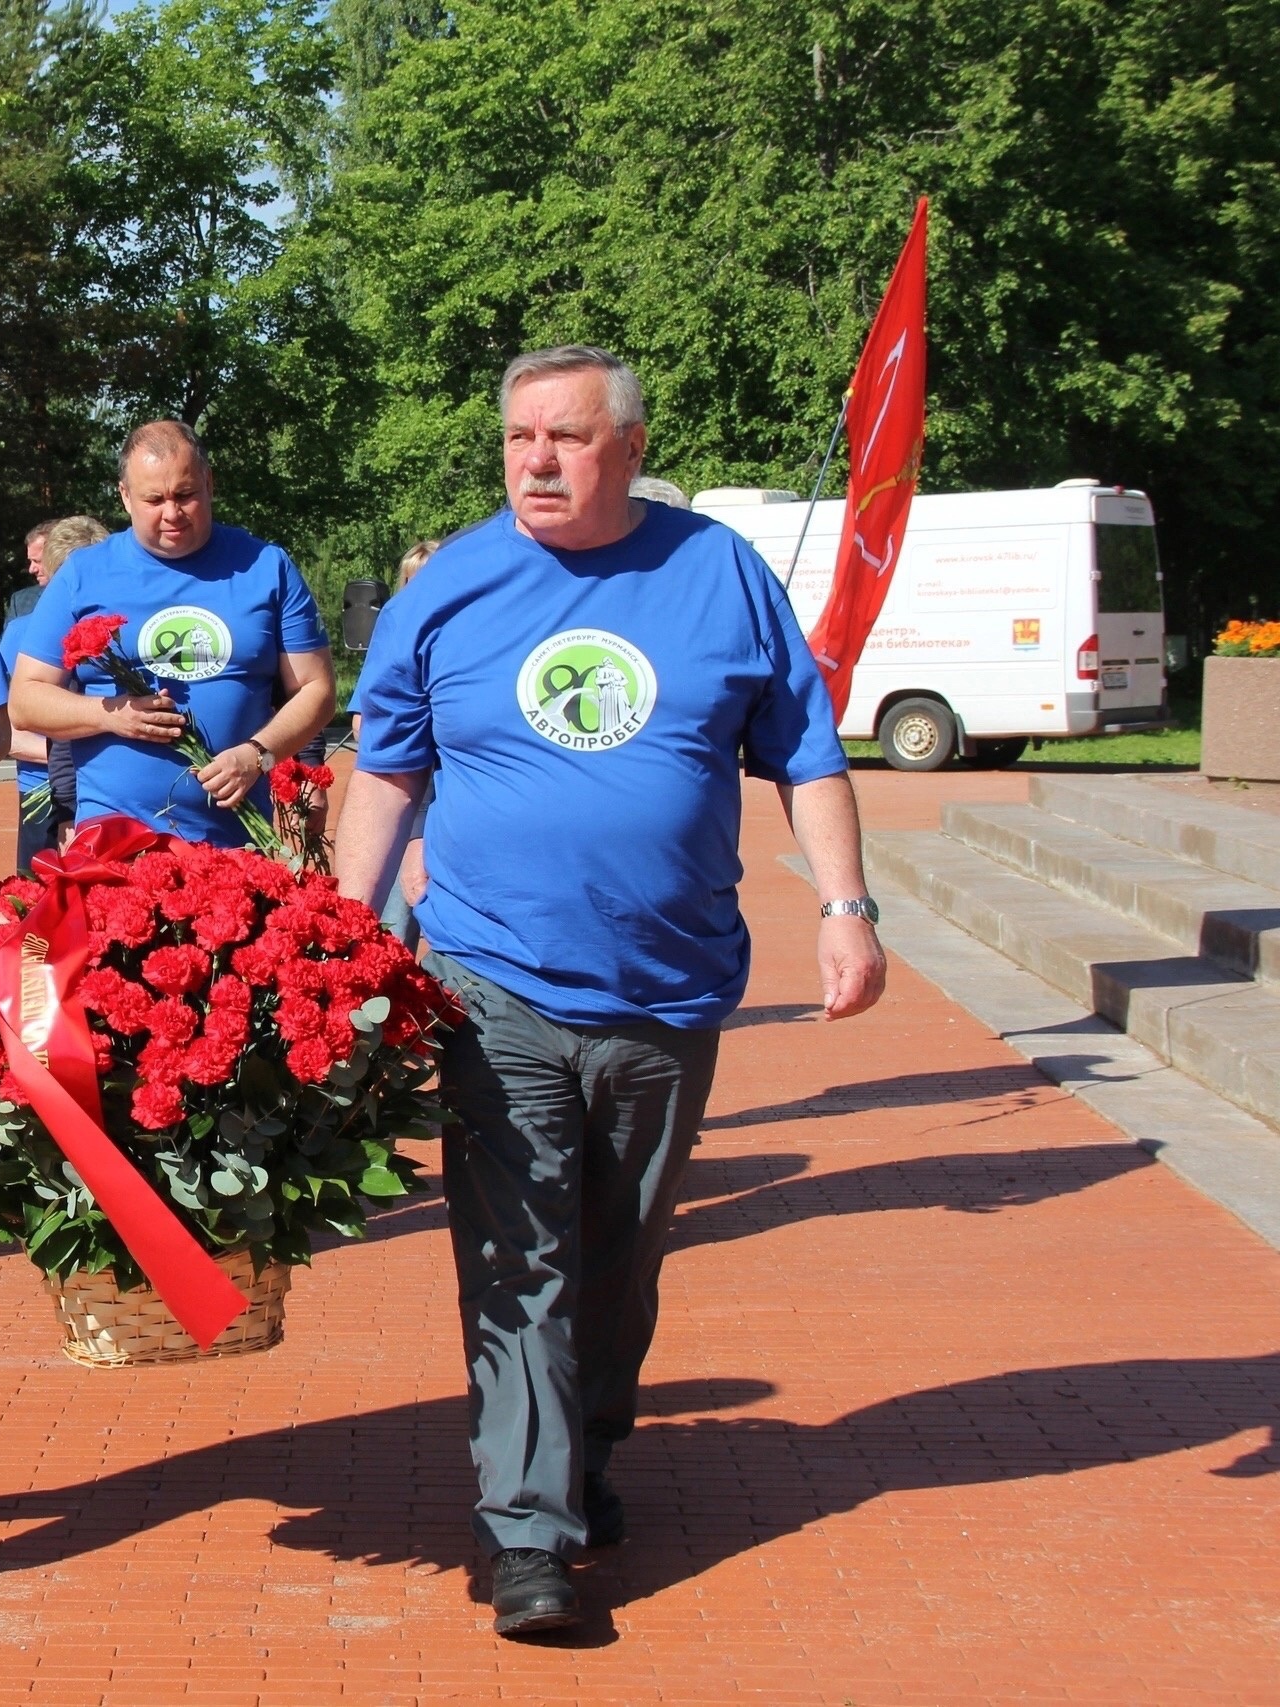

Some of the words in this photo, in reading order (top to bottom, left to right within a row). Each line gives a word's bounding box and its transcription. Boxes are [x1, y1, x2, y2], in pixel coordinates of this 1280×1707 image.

[531, 634, 597, 667] САНКТ-ПЕТЕРБУРГ
[601, 637, 640, 664] МУРМАНСК
[886, 637, 970, 649] библиотека»
[144, 659, 224, 680] АВТОПРОБЕГ
[526, 709, 643, 749] АВТОПРОБЕГ
